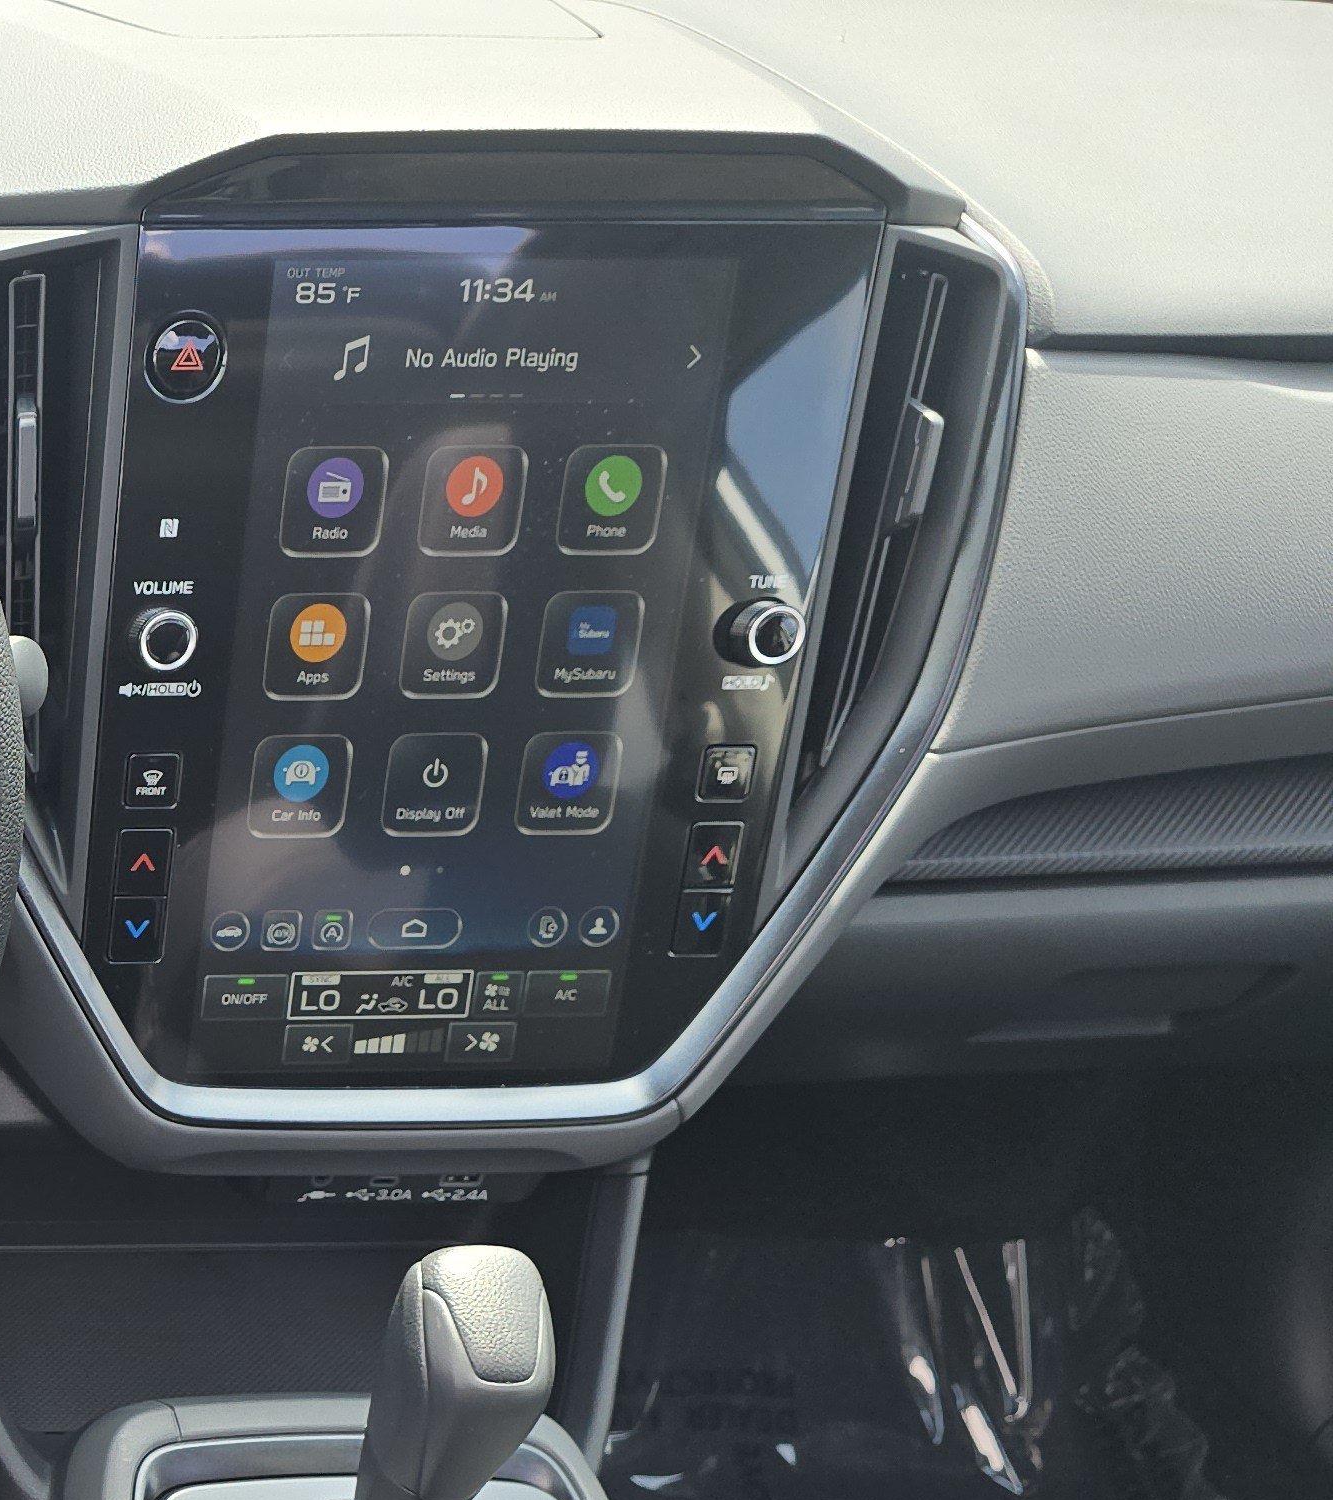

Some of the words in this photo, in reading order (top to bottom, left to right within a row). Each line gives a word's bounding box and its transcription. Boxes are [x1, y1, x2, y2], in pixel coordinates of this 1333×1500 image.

[287, 267, 311, 279] OUT
[316, 267, 346, 279] TEMP
[295, 282, 337, 304] 85
[459, 278, 536, 303] 11:34
[539, 291, 557, 302] AM
[405, 348, 434, 369] No
[440, 348, 498, 368] Audio
[505, 348, 580, 372] Playing
[312, 526, 349, 541] Radio
[450, 525, 488, 539] Media
[586, 524, 627, 538] Phone
[133, 580, 195, 596] VOLUME
[749, 574, 788, 590] TUNE
[297, 671, 330, 686] Apps
[423, 668, 477, 685] Settings
[554, 668, 618, 683] MySubaru
[148, 684, 186, 695] HOLD
[135, 786, 167, 796] FRONT
[271, 808, 295, 822] Car
[298, 808, 322, 823] Info
[395, 806, 442, 823] Display
[445, 806, 466, 820] Off
[529, 805, 562, 819] Valet
[566, 806, 600, 819] Mode
[390, 975, 414, 988] A/C
[221, 993, 269, 1007] ON/OFF
[299, 989, 341, 1012] LO
[417, 988, 460, 1010] LO
[554, 988, 578, 1002] A/C
[482, 998, 510, 1012] ALL
